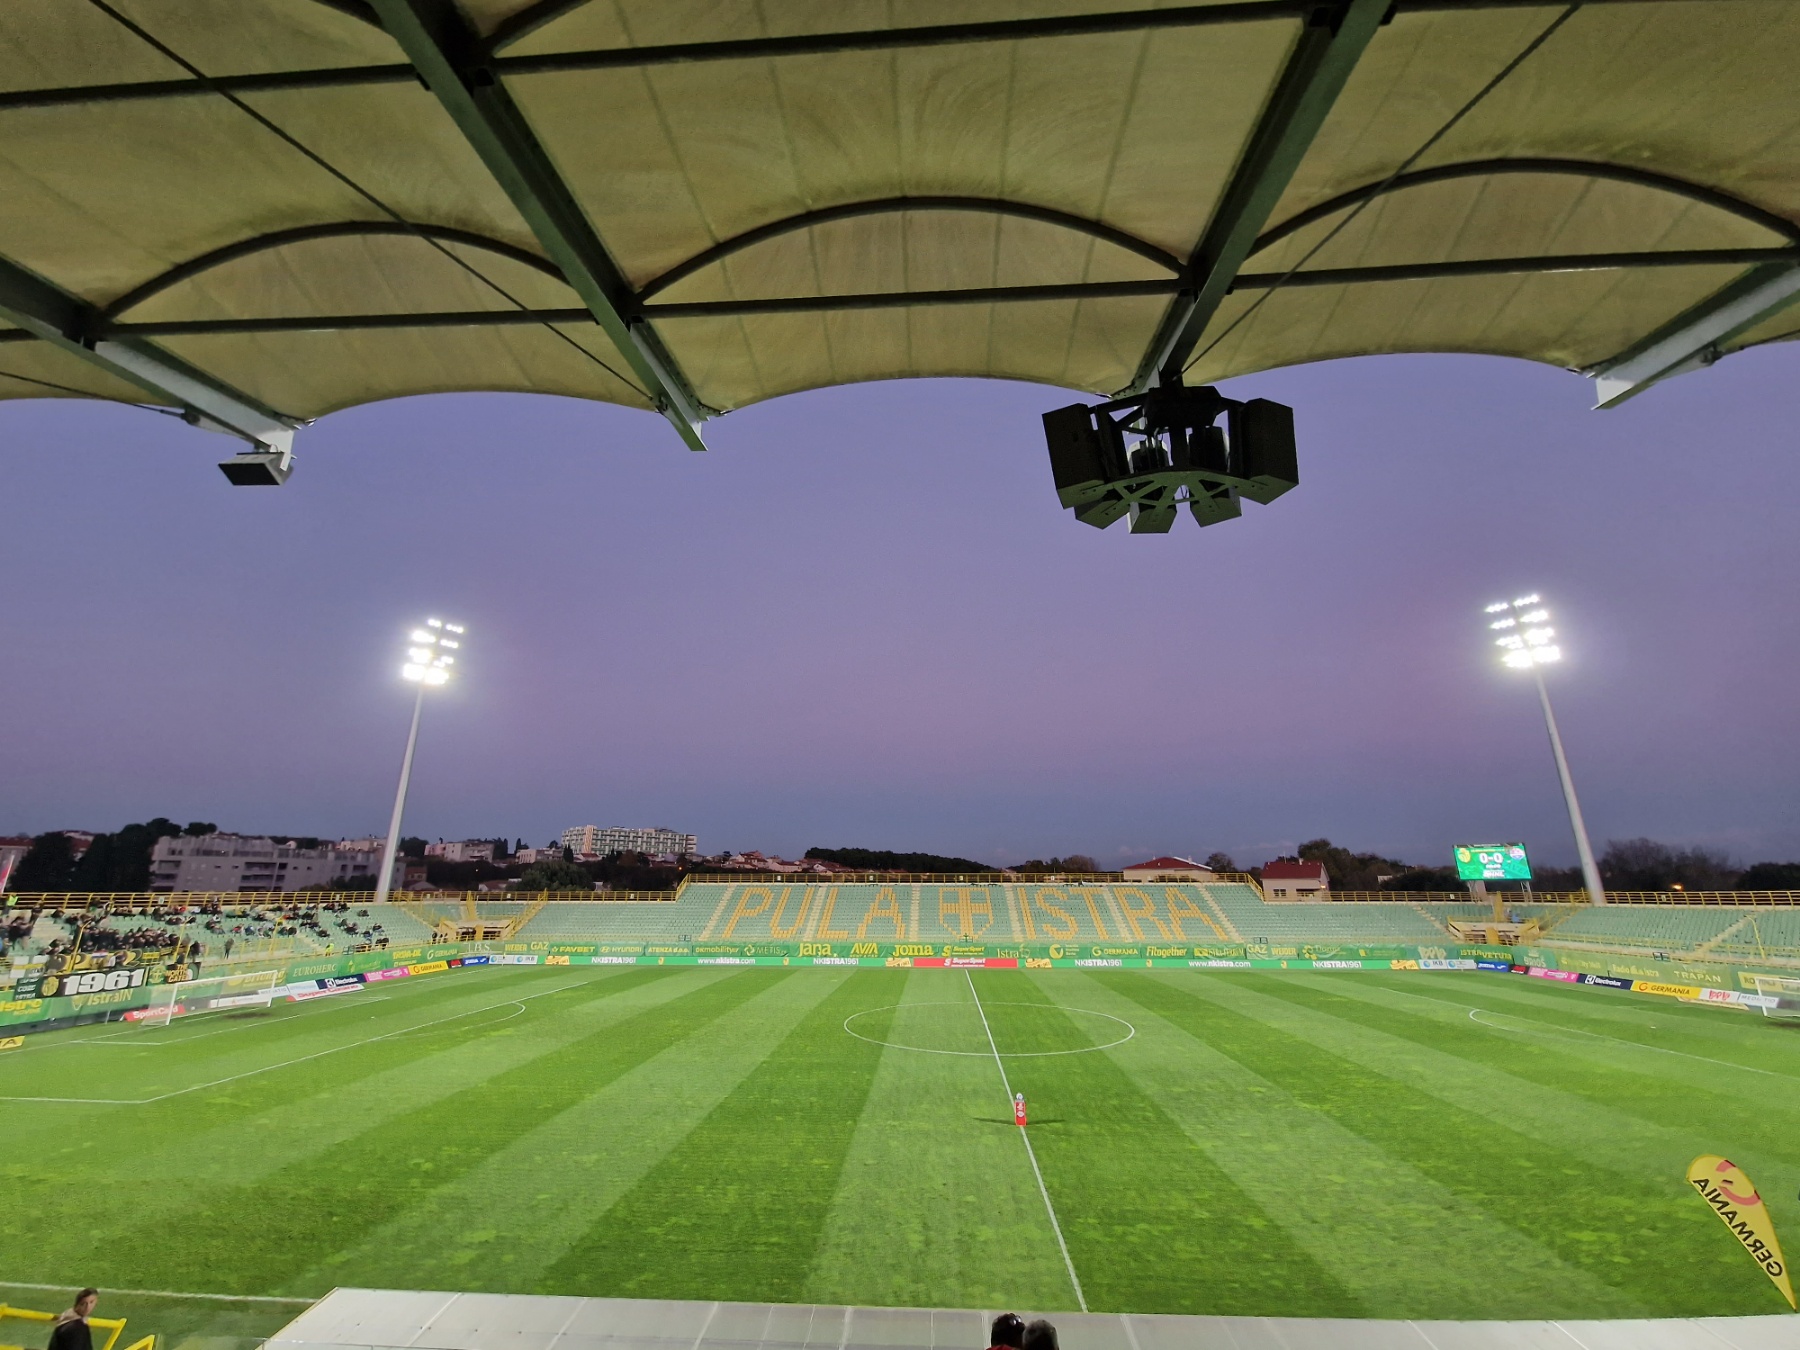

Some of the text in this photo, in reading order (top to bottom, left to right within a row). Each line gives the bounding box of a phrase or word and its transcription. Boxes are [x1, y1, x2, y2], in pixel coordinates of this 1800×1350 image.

[722, 887, 1229, 941] PULA ISTRA
[530, 941, 549, 950] GAZ
[756, 946, 780, 954] METIS
[1247, 944, 1267, 954] GAZ
[997, 948, 1019, 958] Istra
[292, 963, 337, 977] EUROHERC
[420, 963, 443, 972] GERMANIA
[1674, 970, 1721, 983] TRAPAN
[63, 969, 145, 995] 1961
[1650, 984, 1690, 995] GERMANIA
